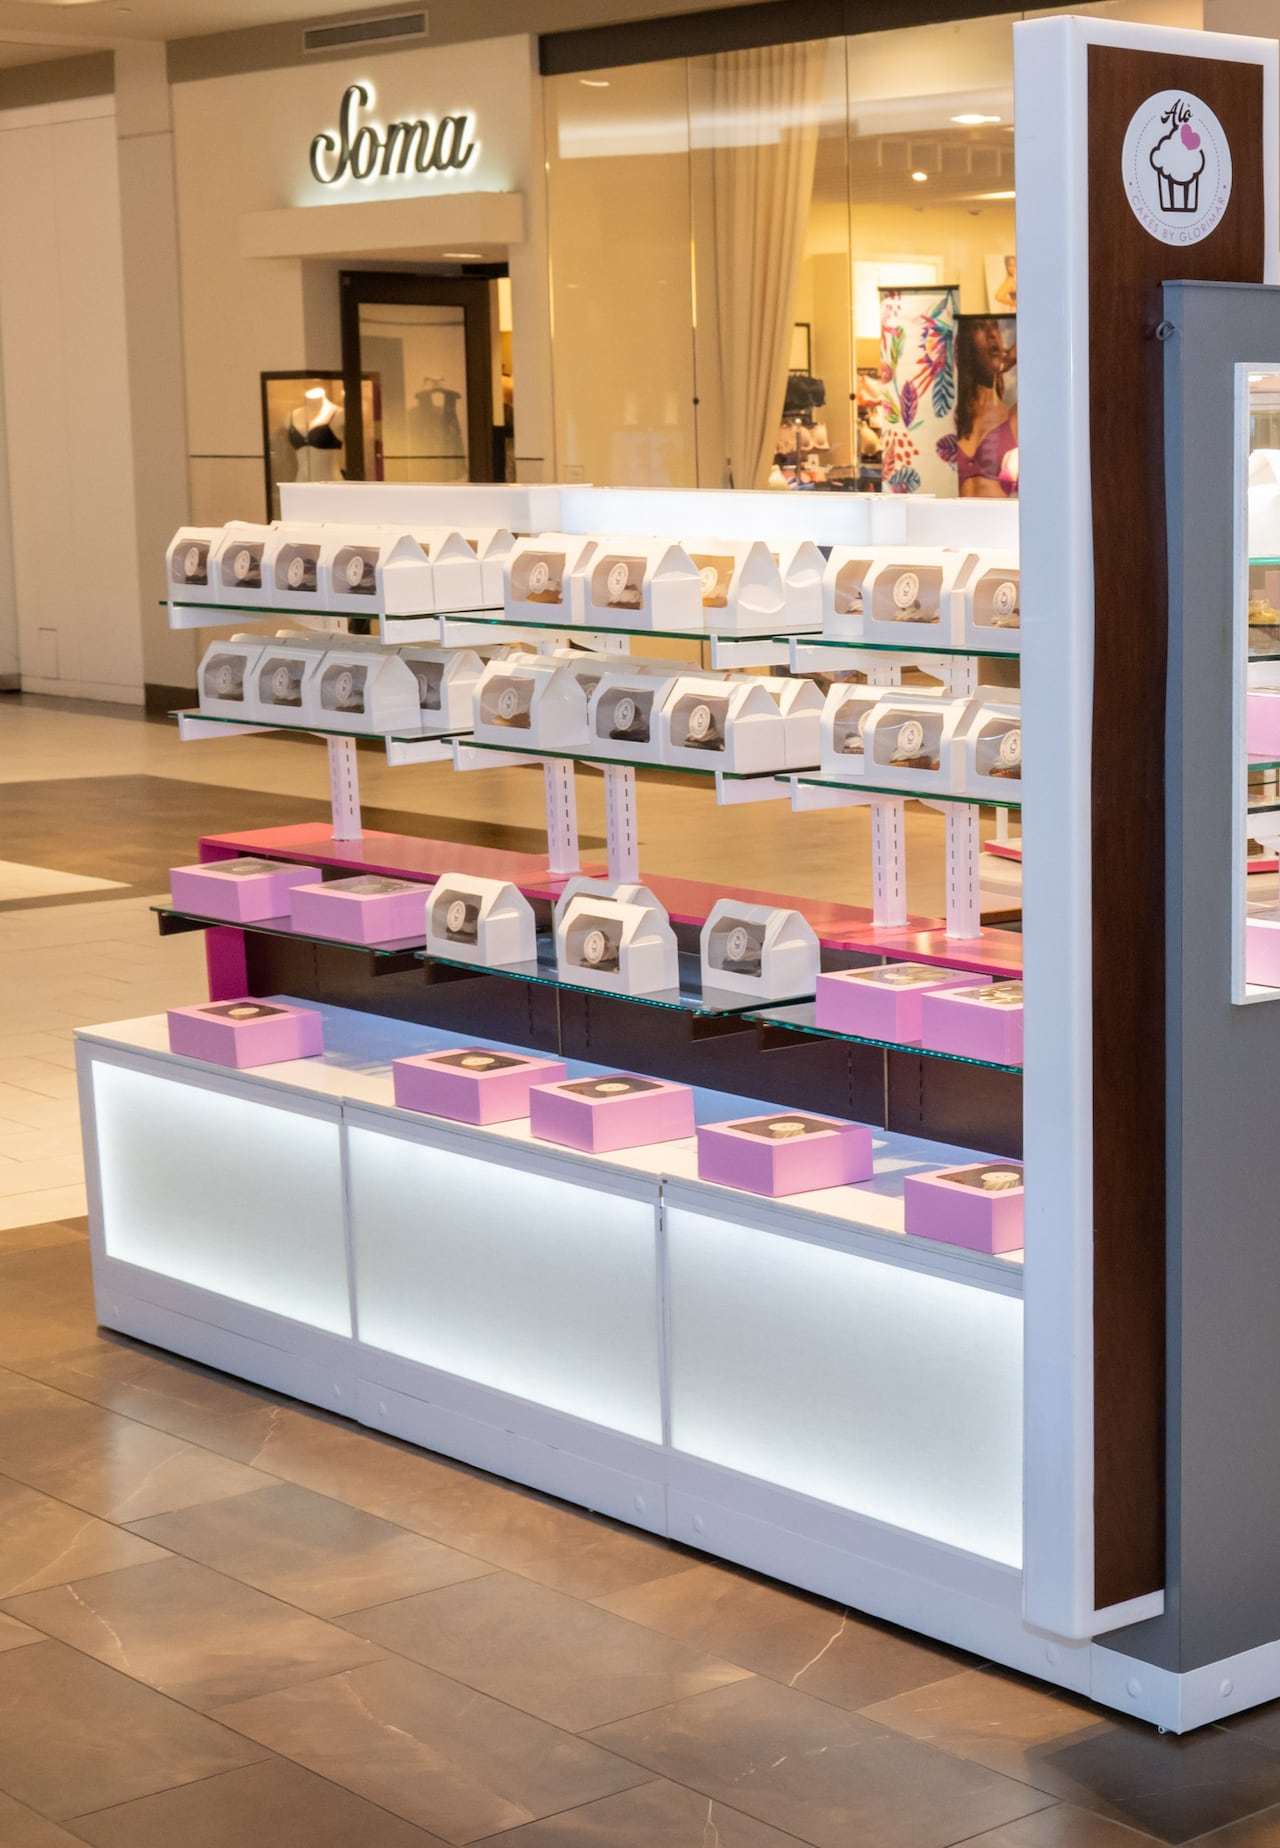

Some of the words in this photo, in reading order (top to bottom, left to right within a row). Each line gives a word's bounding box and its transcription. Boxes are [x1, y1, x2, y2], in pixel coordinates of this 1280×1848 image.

[310, 85, 474, 184] Soma
[1131, 195, 1159, 233] CAKES
[1162, 230, 1175, 241] BY
[1179, 196, 1226, 242] GLORIMAR
